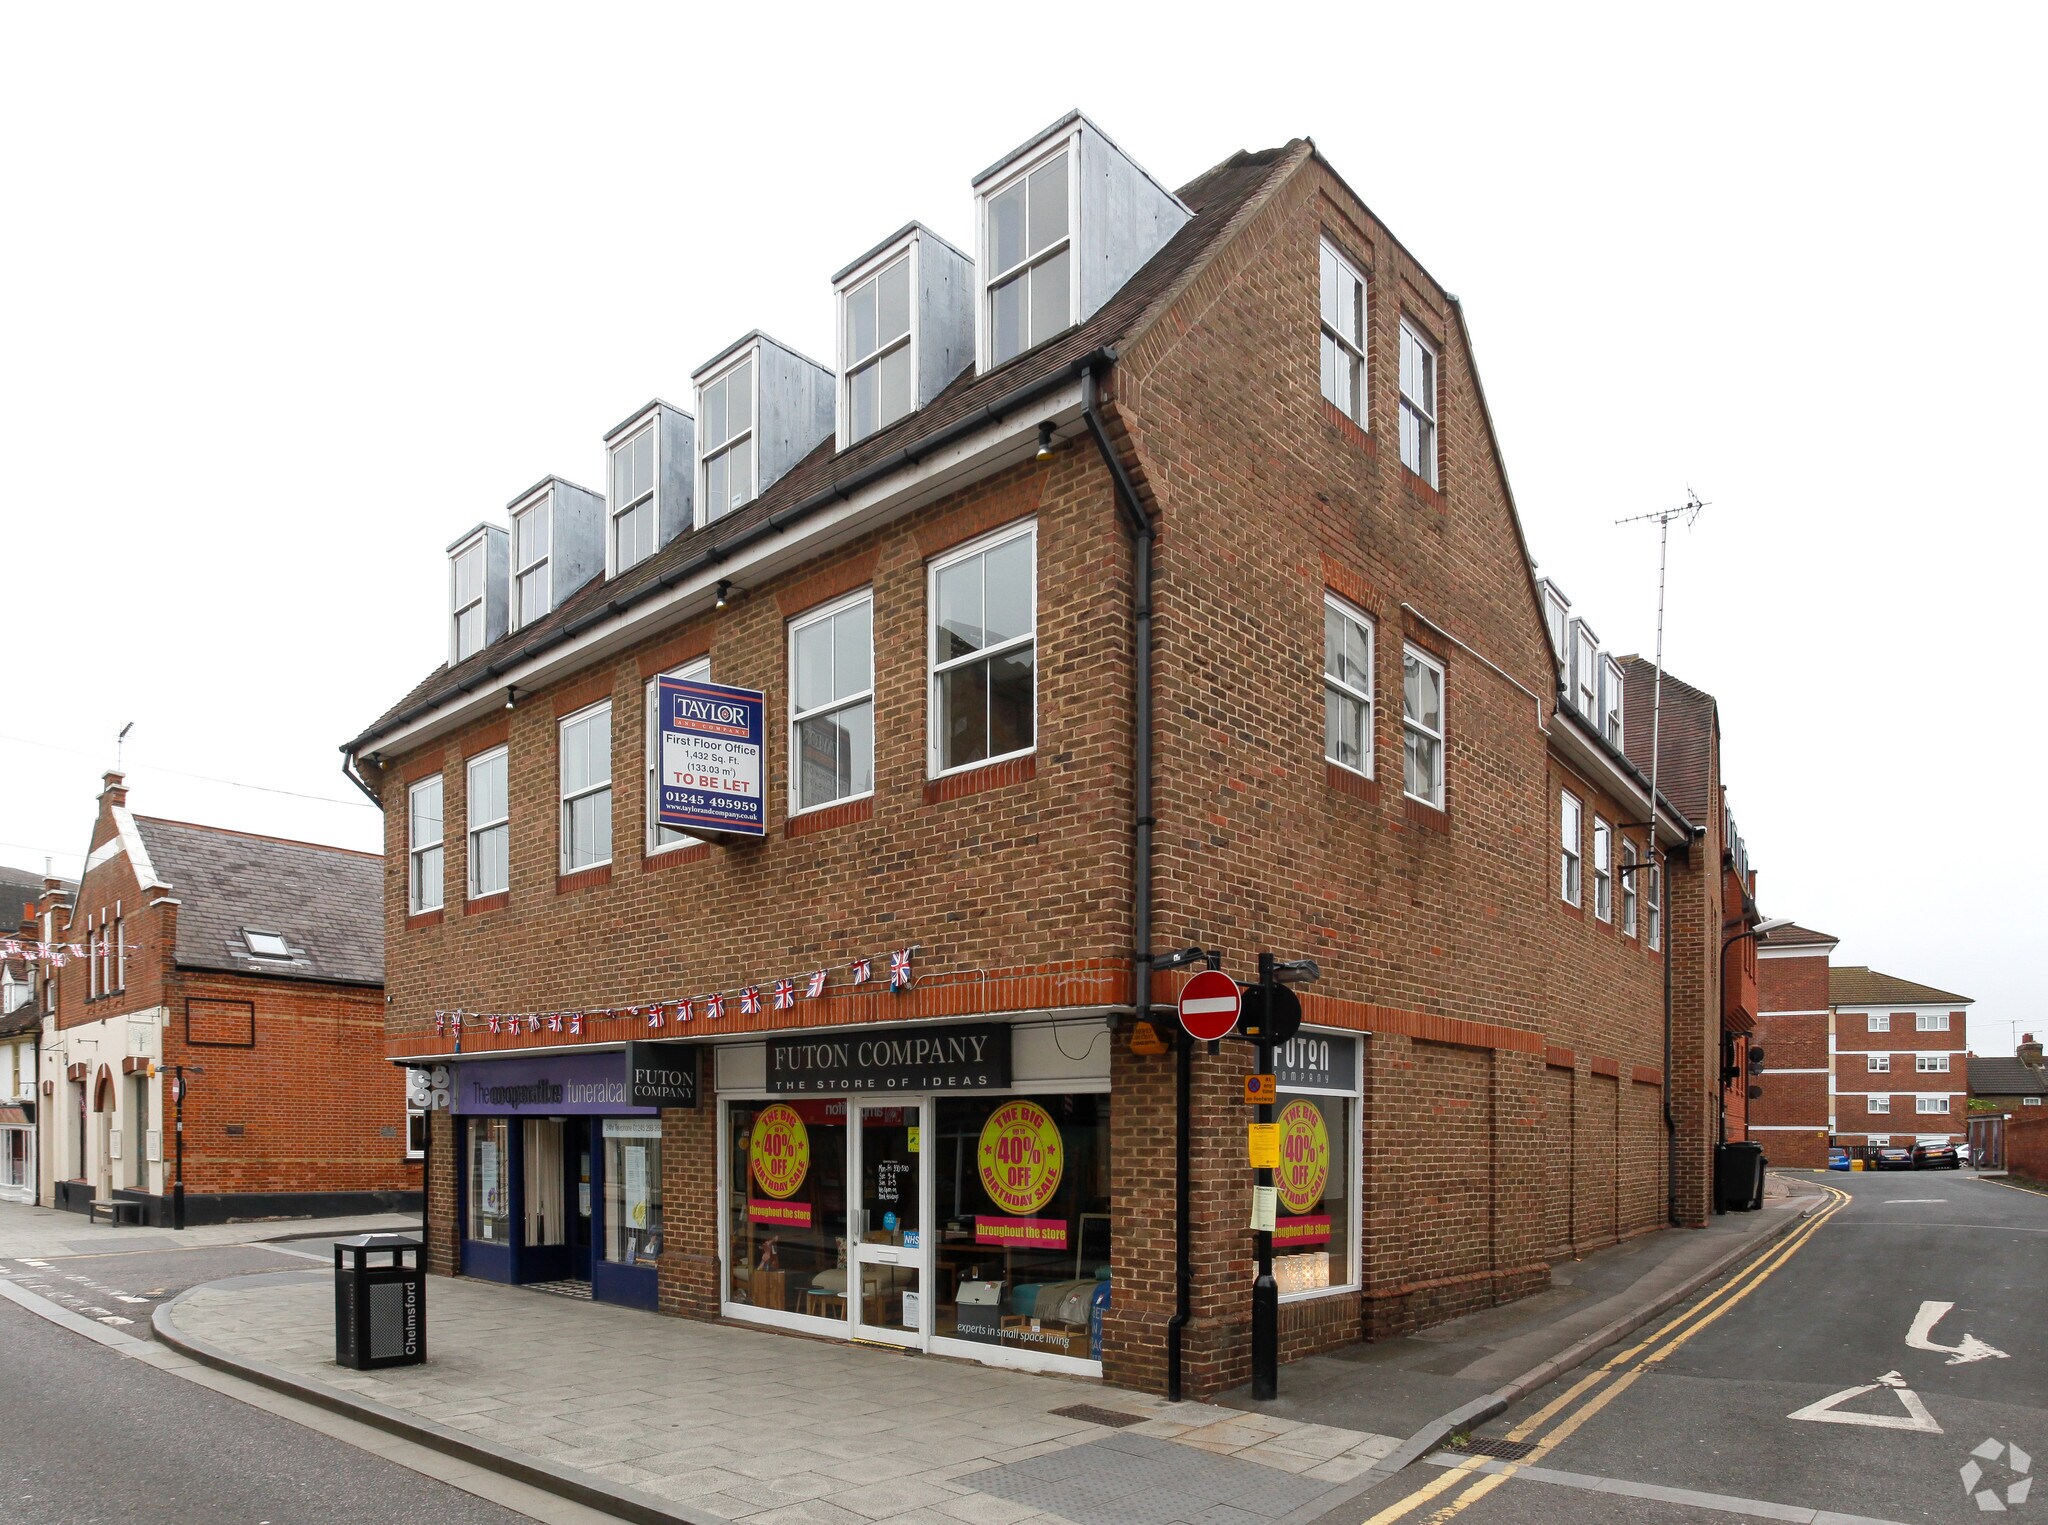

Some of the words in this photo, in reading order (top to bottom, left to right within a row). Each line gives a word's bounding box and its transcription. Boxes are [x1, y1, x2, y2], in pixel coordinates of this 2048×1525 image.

[677, 698, 746, 726] TAYLOR
[677, 720, 696, 728] AND
[702, 723, 746, 735] COMPANY
[666, 733, 691, 746] First
[693, 737, 722, 751] Floor
[724, 742, 756, 756] Office
[685, 750, 709, 761] 1,432
[711, 753, 726, 764] Sq.
[728, 756, 740, 765] Ft.
[687, 762, 720, 775] (133.03
[673, 771, 695, 785] TO
[699, 775, 719, 789] BE
[723, 778, 750, 793] LET
[665, 790, 705, 805] 01245
[708, 797, 758, 812] 495959
[665, 803, 758, 820] www.taylorandcompany.co.uk
[774, 1043, 850, 1070] FUTON
[858, 1035, 988, 1067] COMPANY
[634, 1068, 694, 1086] FUTON
[776, 1080, 806, 1090] THE
[817, 1079, 875, 1089] STORE
[887, 1078, 909, 1087] OF
[923, 1075, 988, 1087] IDEAS
[473, 1081, 490, 1104] The
[634, 1085, 694, 1098] COMPANY
[762, 1109, 779, 1127] THE
[780, 1109, 798, 1128] BIG
[993, 1107, 1019, 1130] THE
[1021, 1107, 1045, 1130] BIG
[1283, 1105, 1301, 1126] THE
[1302, 1105, 1319, 1129] BIG
[763, 1133, 794, 1157] 40%
[997, 1136, 1041, 1165] 40%
[1285, 1134, 1316, 1163] 40%
[753, 1157, 789, 1192] BIRTHDAY
[789, 1159, 806, 1187] SALE
[771, 1158, 788, 1176] OFF
[1007, 1166, 1032, 1187] OFF
[1292, 1165, 1309, 1185] OFF
[982, 1166, 1033, 1206] BIRTHDAY
[1034, 1166, 1059, 1200] SALE
[1310, 1165, 1326, 1197] SALE
[749, 1205, 782, 1218] throughout
[782, 1207, 794, 1219] the
[794, 1208, 811, 1220] store
[904, 1234, 920, 1245] NHS
[976, 1223, 1025, 1238] throughout
[1025, 1226, 1041, 1239] the
[1041, 1227, 1066, 1241] store
[1303, 1224, 1314, 1235] the
[1314, 1223, 1330, 1234] store
[404, 1282, 416, 1355] Chelmsford
[957, 1323, 986, 1335] experts
[987, 1325, 996, 1336] in
[996, 1327, 1019, 1339] small
[1019, 1332, 1045, 1346] space
[1045, 1333, 1070, 1349] living
